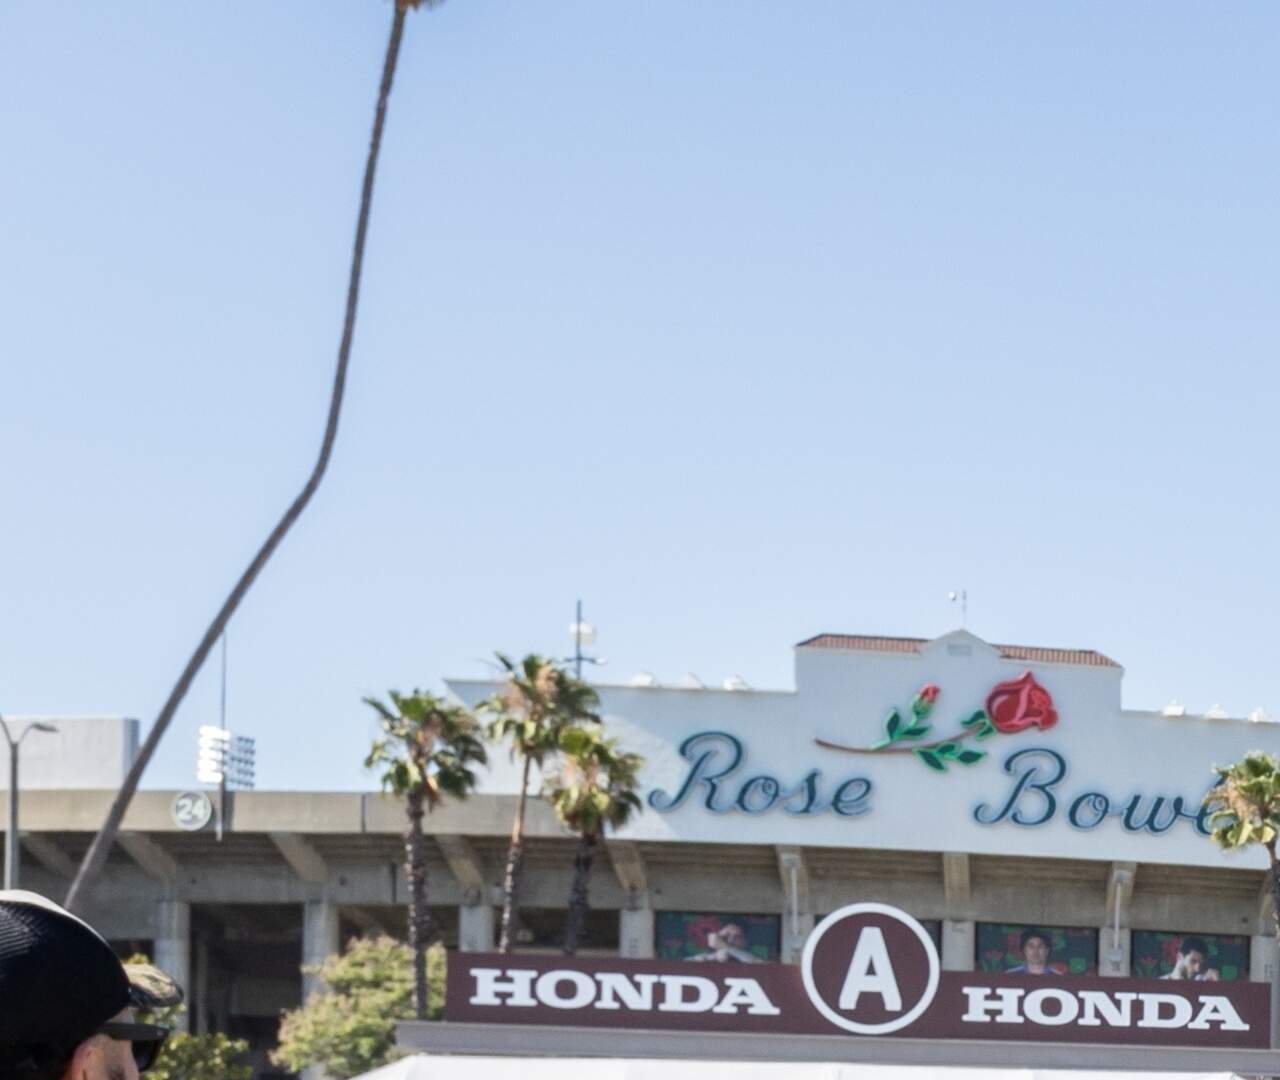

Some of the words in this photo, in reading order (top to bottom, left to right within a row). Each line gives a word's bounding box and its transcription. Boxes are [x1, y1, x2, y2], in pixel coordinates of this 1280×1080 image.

[647, 731, 873, 816] Rose
[178, 798, 206, 820] 24
[469, 967, 781, 1016] HONDA
[839, 926, 903, 1012] A
[961, 986, 1251, 1032] HONDA
